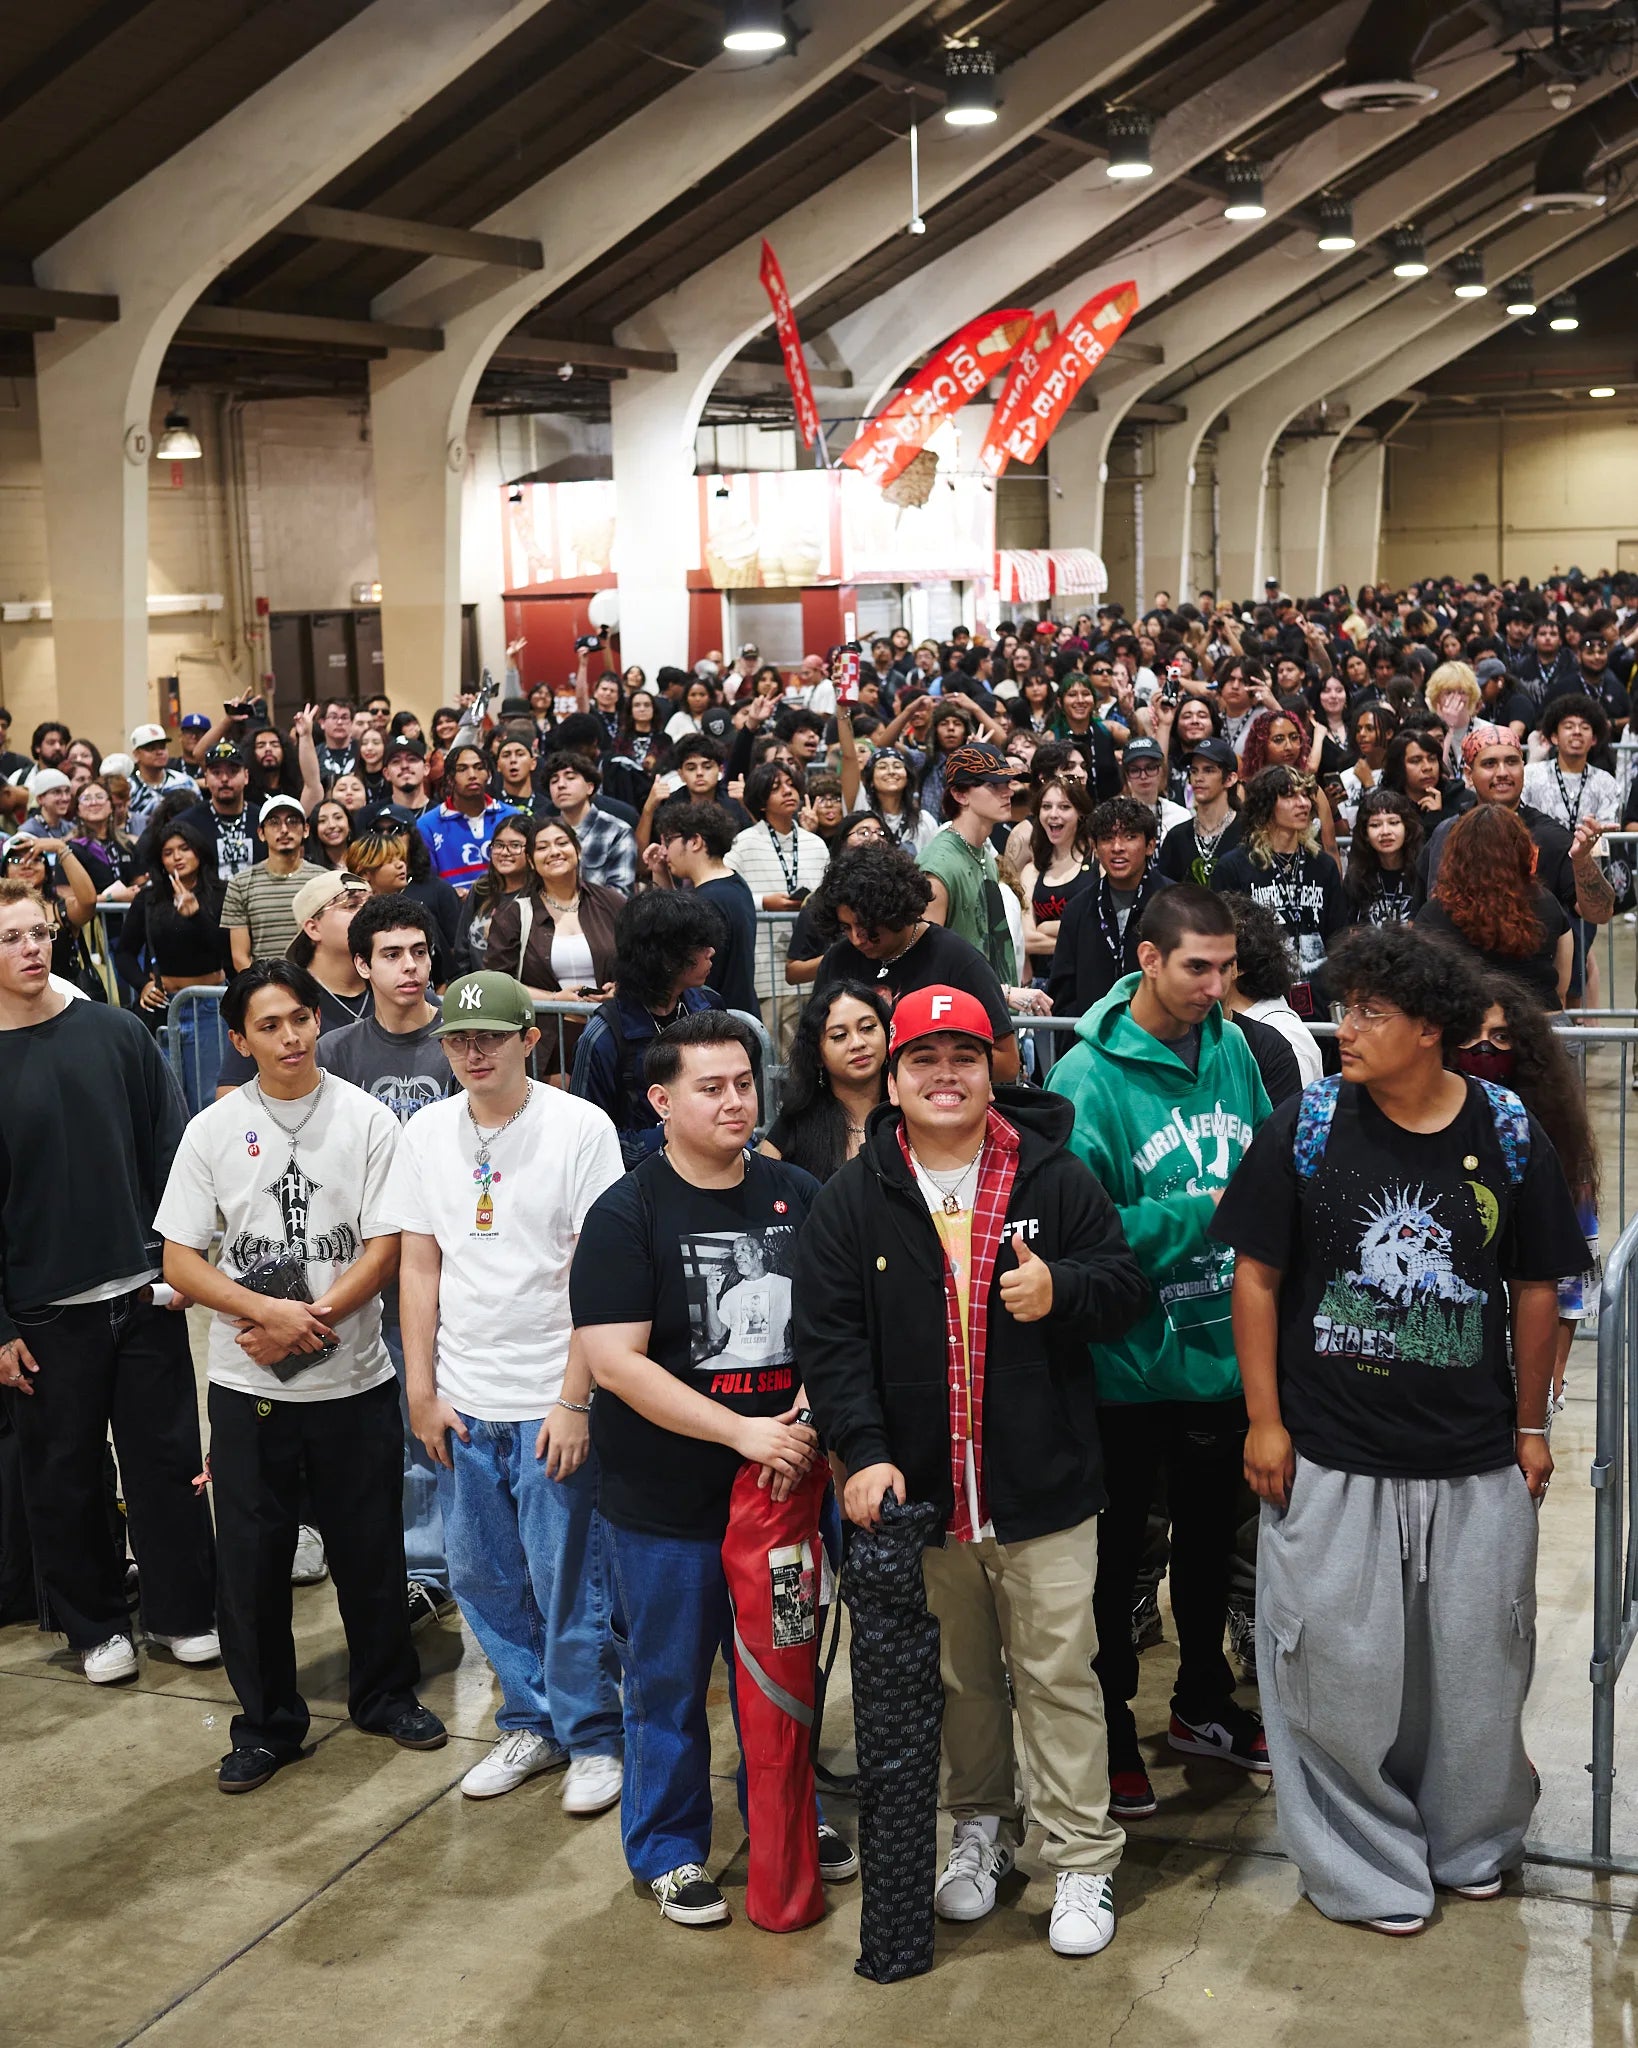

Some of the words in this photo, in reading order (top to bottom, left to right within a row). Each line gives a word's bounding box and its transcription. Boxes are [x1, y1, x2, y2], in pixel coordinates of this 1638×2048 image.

[1067, 323, 1104, 364] ICE
[946, 344, 986, 395] ICE
[1003, 353, 1081, 460] CREAM
[856, 374, 958, 484] CREAM
[458, 983, 483, 1010] NY
[931, 995, 953, 1020] F
[1132, 1123, 1181, 1175] HARD
[480, 1212, 490, 1220] 40
[998, 1218, 1040, 1244] FTP
[710, 1373, 753, 1393] FULL
[757, 1369, 792, 1391] SEND
[1356, 1361, 1390, 1377] UTAH
